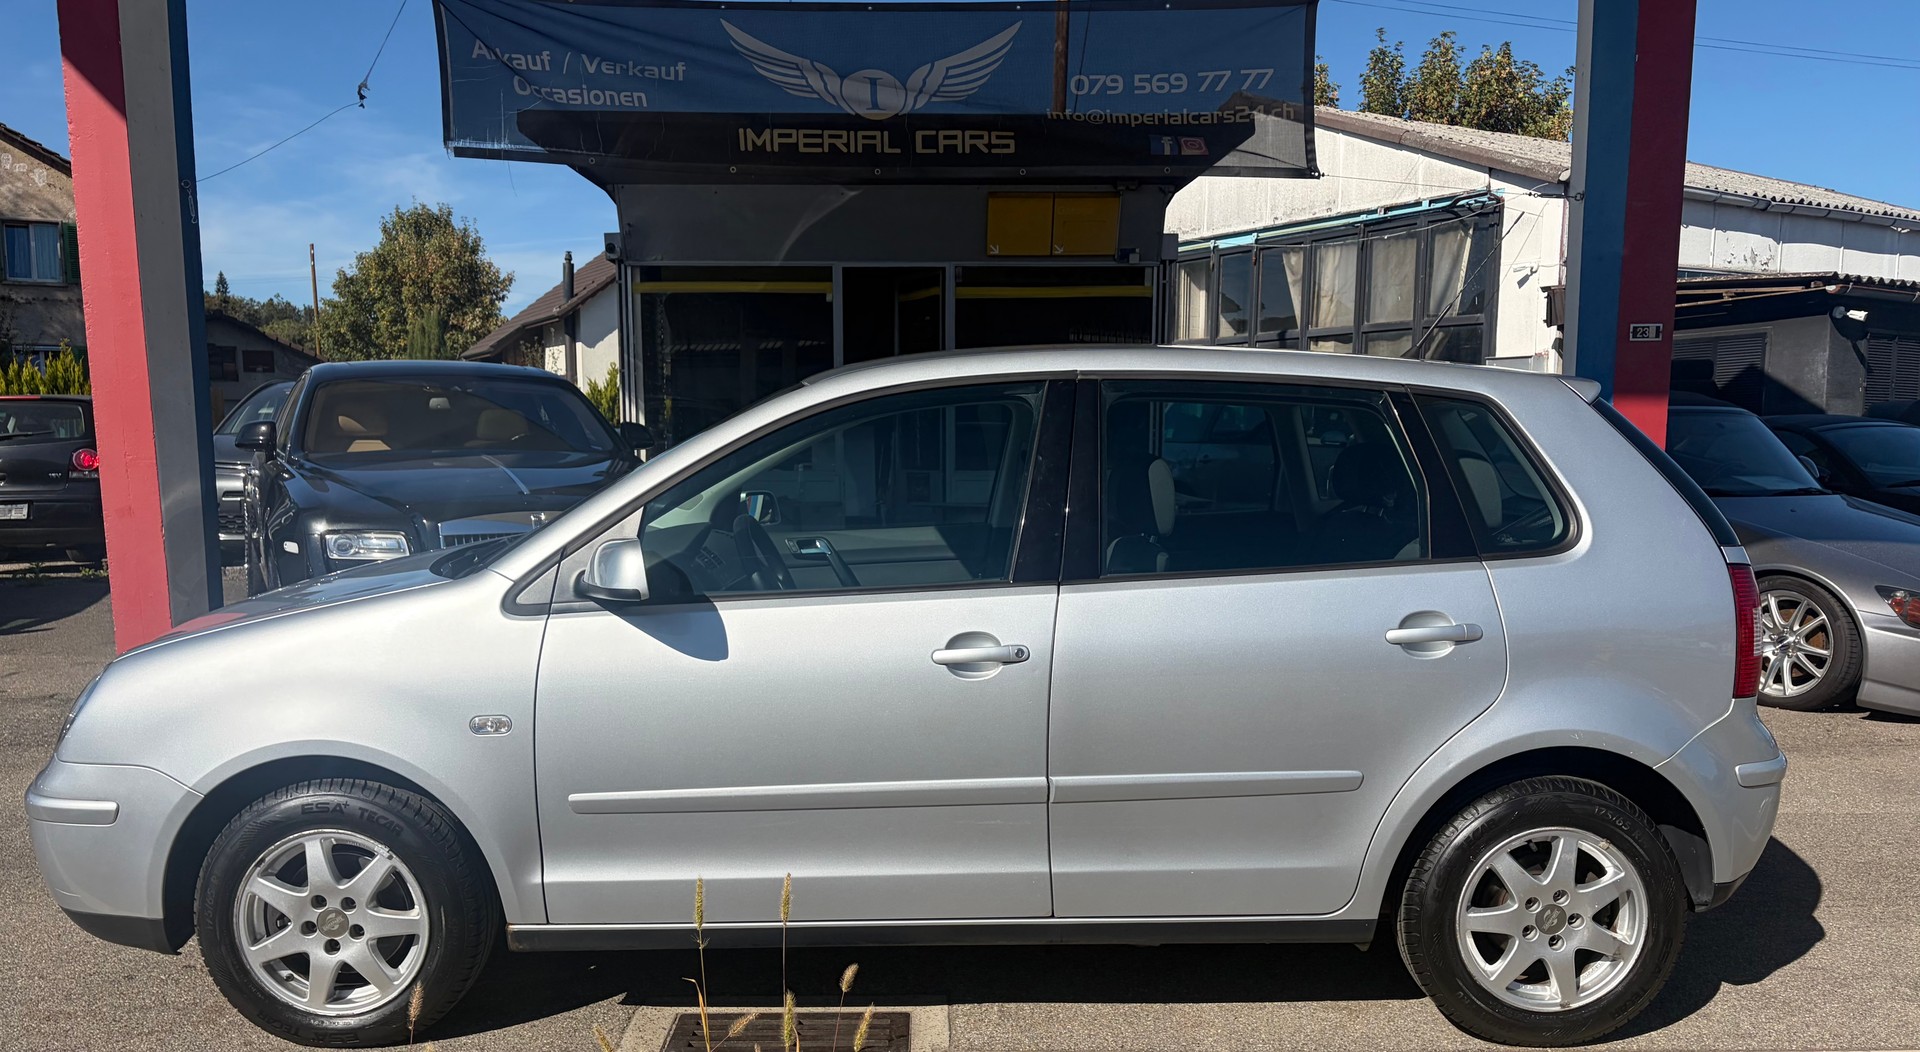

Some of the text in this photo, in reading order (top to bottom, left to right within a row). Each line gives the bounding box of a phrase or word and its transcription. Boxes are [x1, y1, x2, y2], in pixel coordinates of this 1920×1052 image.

[580, 53, 686, 81] Verkauf
[513, 75, 648, 107] Occasionen
[1070, 68, 1274, 95] 079 569 77 77
[738, 127, 1016, 154] IMPERIAL CARS
[1636, 327, 1649, 338] 23
[358, 807, 404, 836] TECAR
